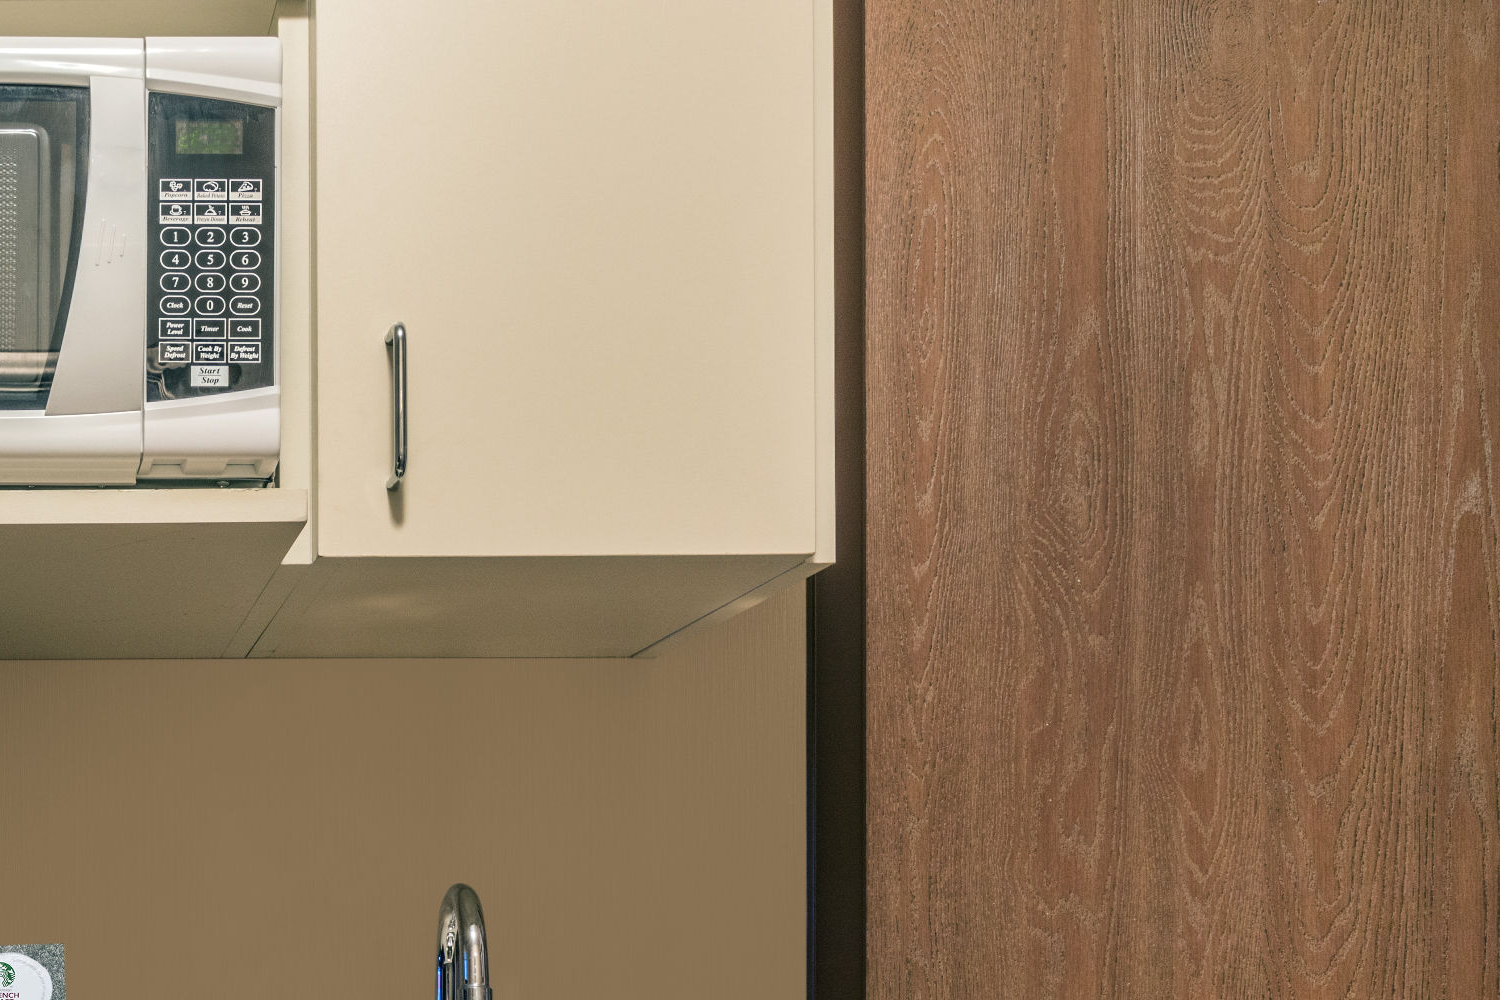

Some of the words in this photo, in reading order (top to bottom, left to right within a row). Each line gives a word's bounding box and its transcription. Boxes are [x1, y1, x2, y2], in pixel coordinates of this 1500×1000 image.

[173, 232, 178, 242] 1
[206, 232, 214, 242] 2
[242, 232, 249, 242] 3
[172, 254, 179, 264] 4
[207, 254, 214, 265] 5
[241, 254, 249, 265] 6
[172, 277, 179, 287] 7
[206, 277, 214, 287] 8
[241, 277, 249, 287] 9
[206, 300, 214, 310] 0
[201, 376, 219, 384] Stop
